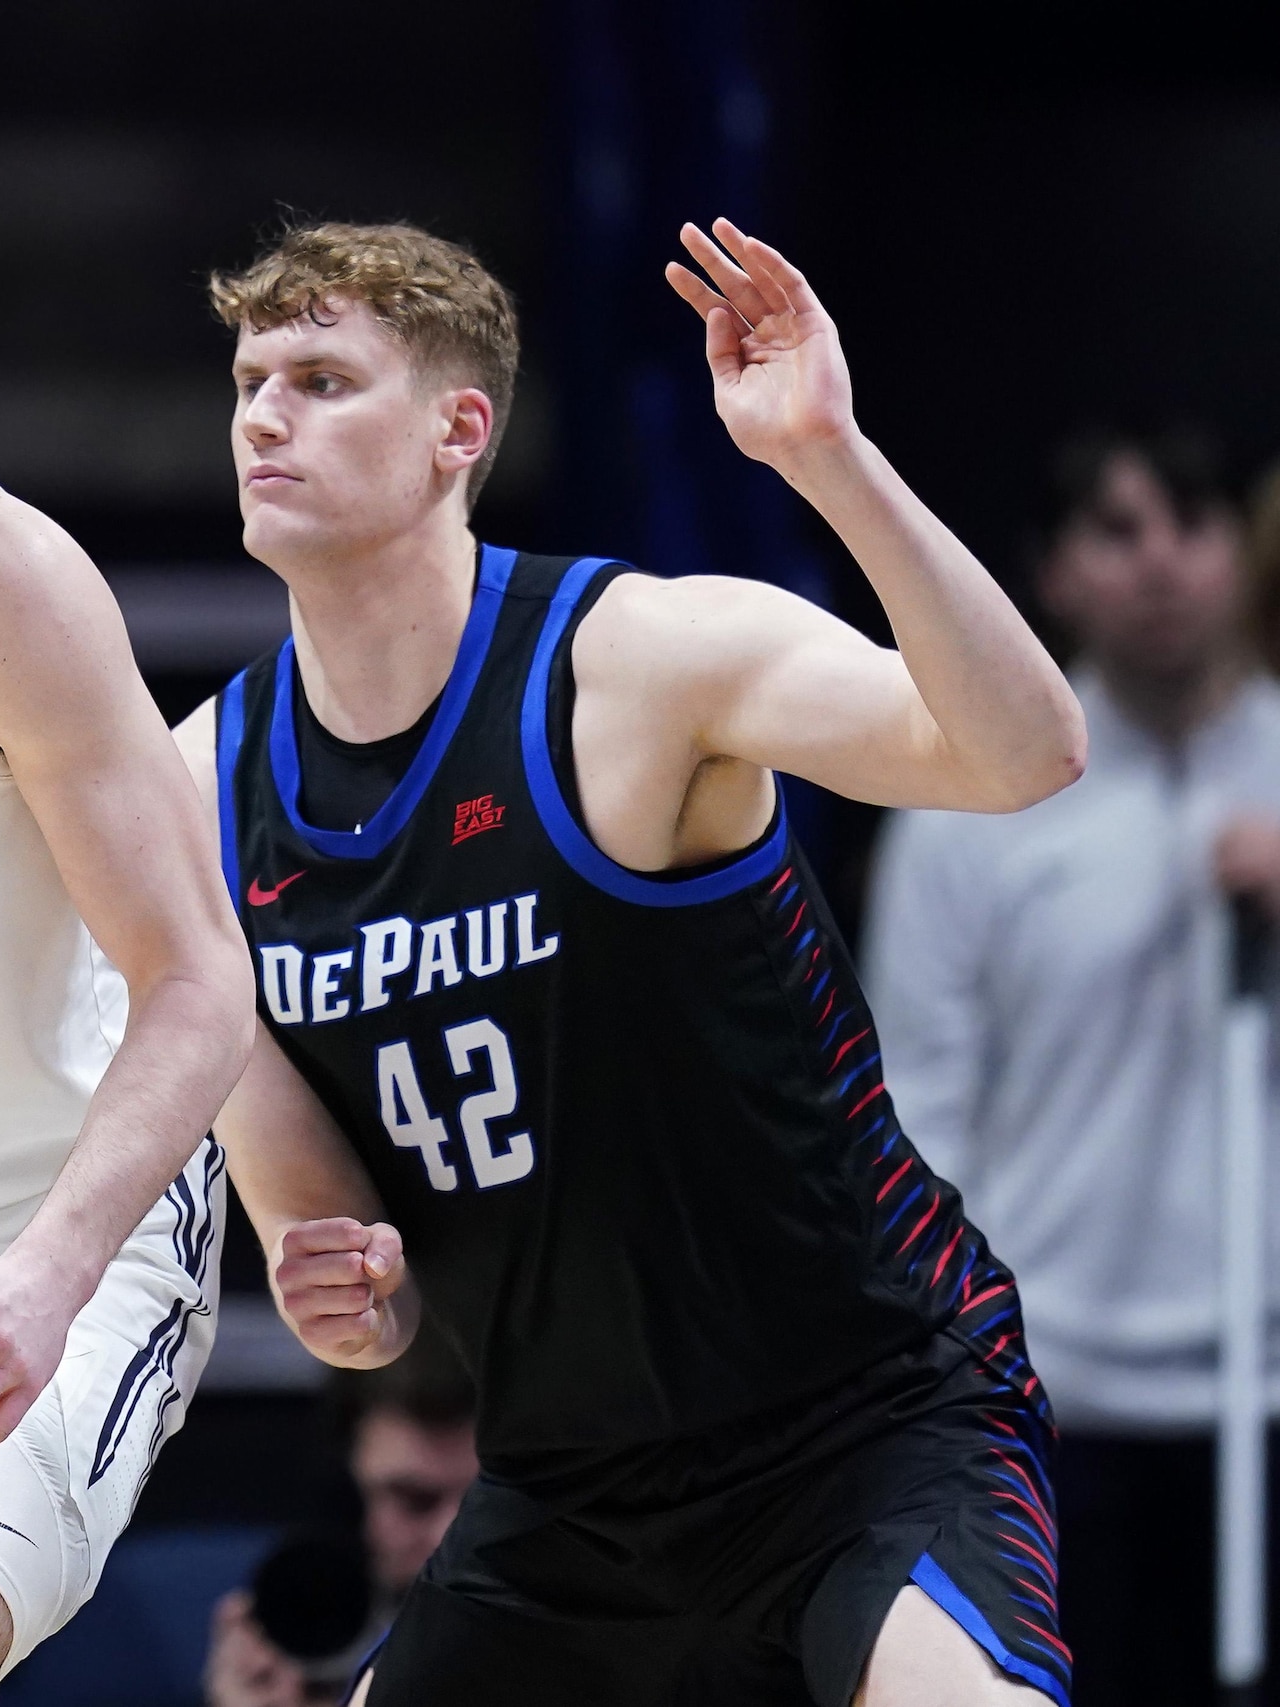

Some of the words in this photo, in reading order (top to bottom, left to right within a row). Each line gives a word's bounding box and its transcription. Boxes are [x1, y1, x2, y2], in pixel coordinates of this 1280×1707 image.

[454, 805, 506, 836] EAST
[456, 794, 494, 820] BIG
[375, 1016, 535, 1194] 42
